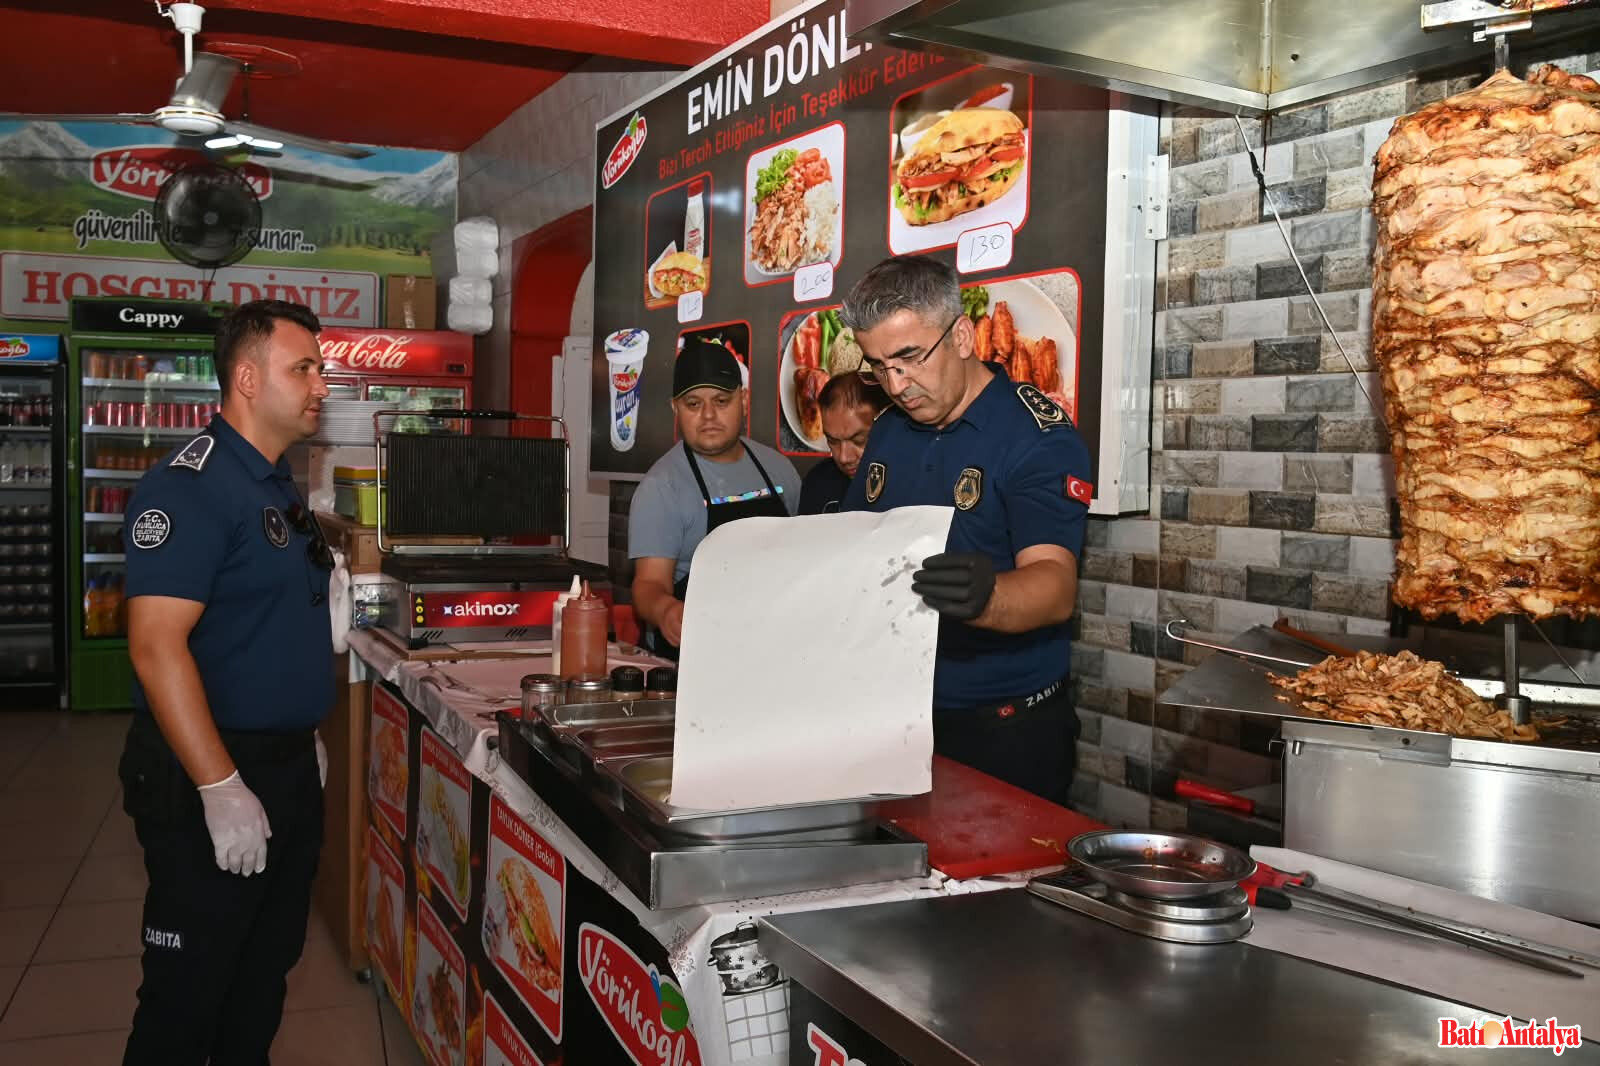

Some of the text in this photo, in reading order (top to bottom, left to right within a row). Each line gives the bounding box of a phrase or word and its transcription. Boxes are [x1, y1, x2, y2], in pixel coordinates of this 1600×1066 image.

[687, 57, 753, 135] EMİN
[801, 65, 879, 118] Teşekkür
[119, 307, 184, 329] Cappy
[454, 601, 520, 616] akinox
[145, 927, 181, 949] ZABITA
